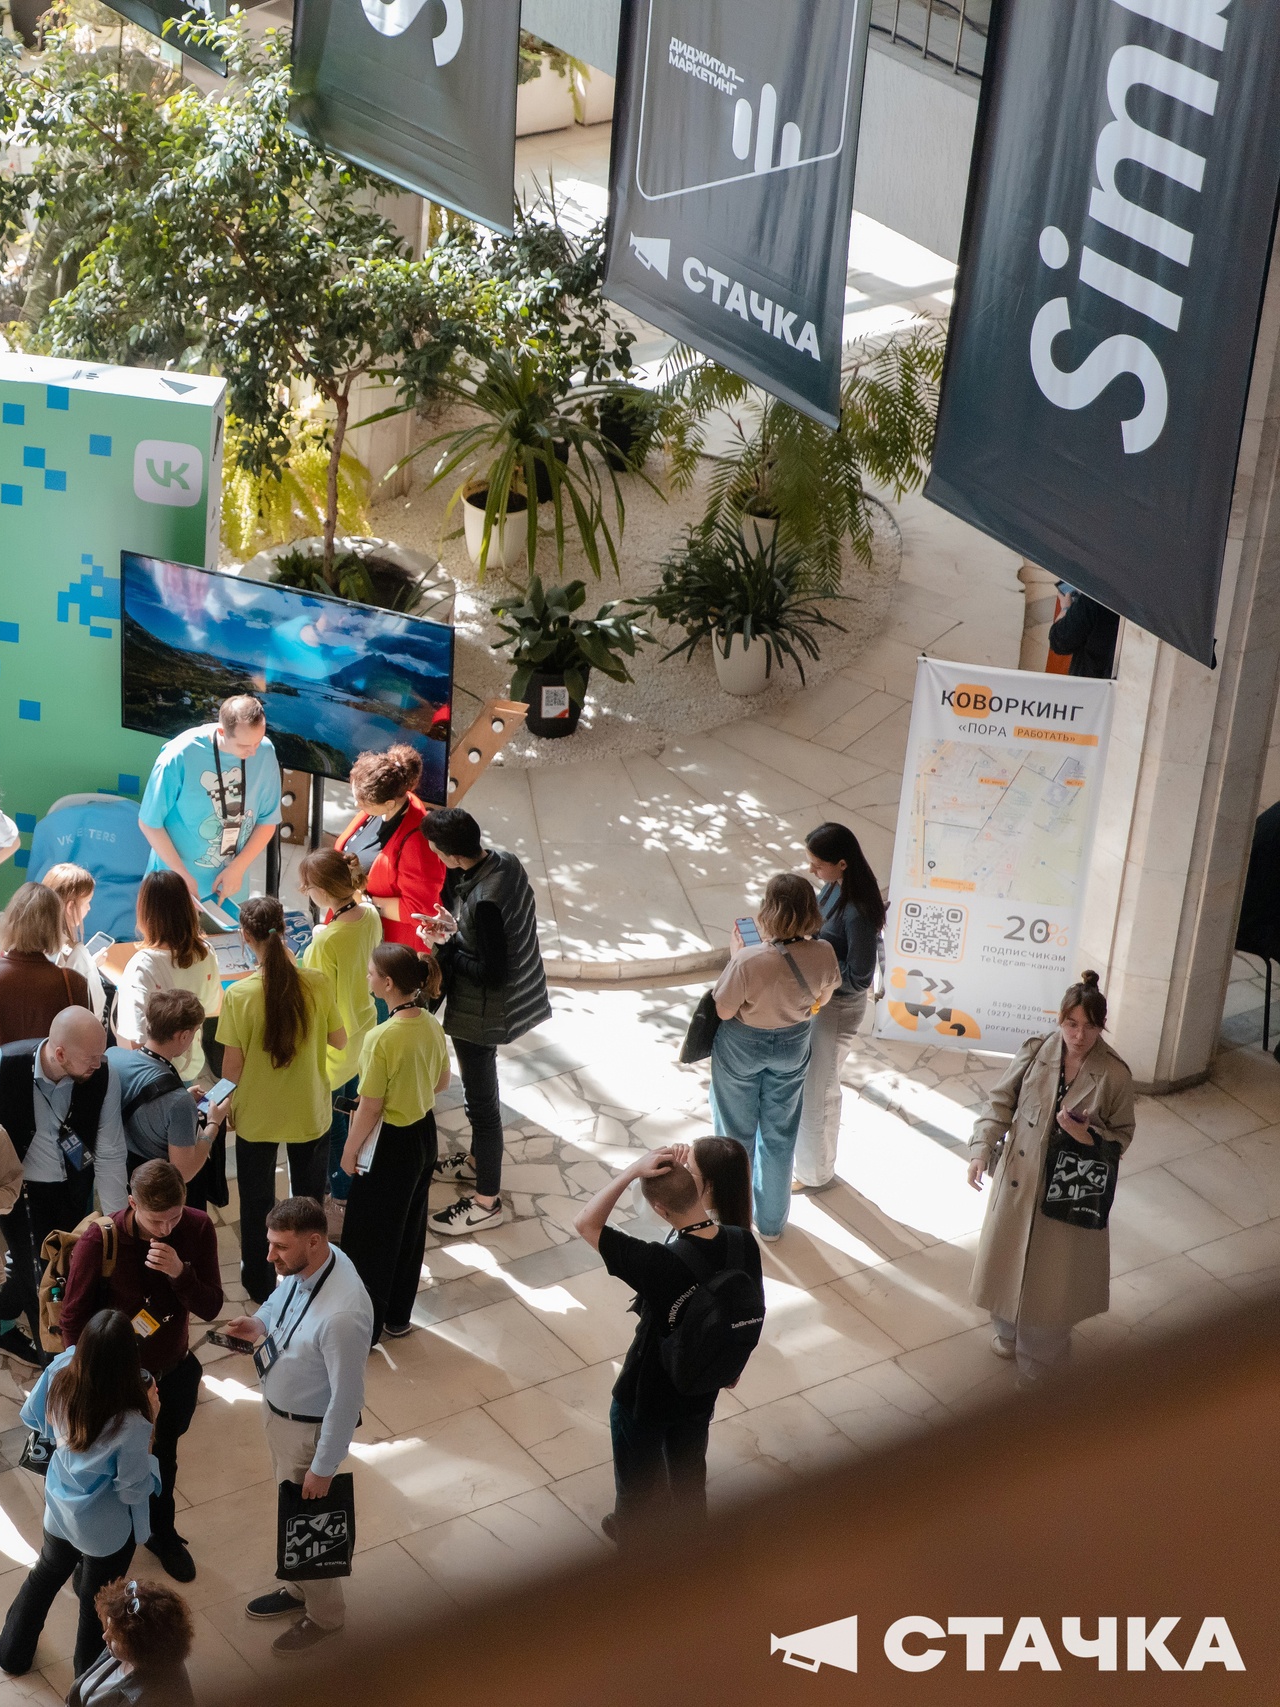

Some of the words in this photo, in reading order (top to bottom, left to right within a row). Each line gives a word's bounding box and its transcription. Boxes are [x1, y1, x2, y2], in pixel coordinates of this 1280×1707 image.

[669, 53, 737, 97] МАРКЕТИНГ
[682, 256, 821, 362] СТАЧКА
[941, 690, 1084, 722] КОВОРКИНГ
[958, 722, 1007, 738] «ПОРА
[1017, 728, 1076, 743] РАБОТАТЬ»
[56, 833, 74, 846] VK
[76, 827, 117, 843] ETERS
[980, 955, 1065, 973] Telegram-канала
[982, 945, 1066, 962] подписчикам
[668, 1282, 699, 1323] ERNATIONAL
